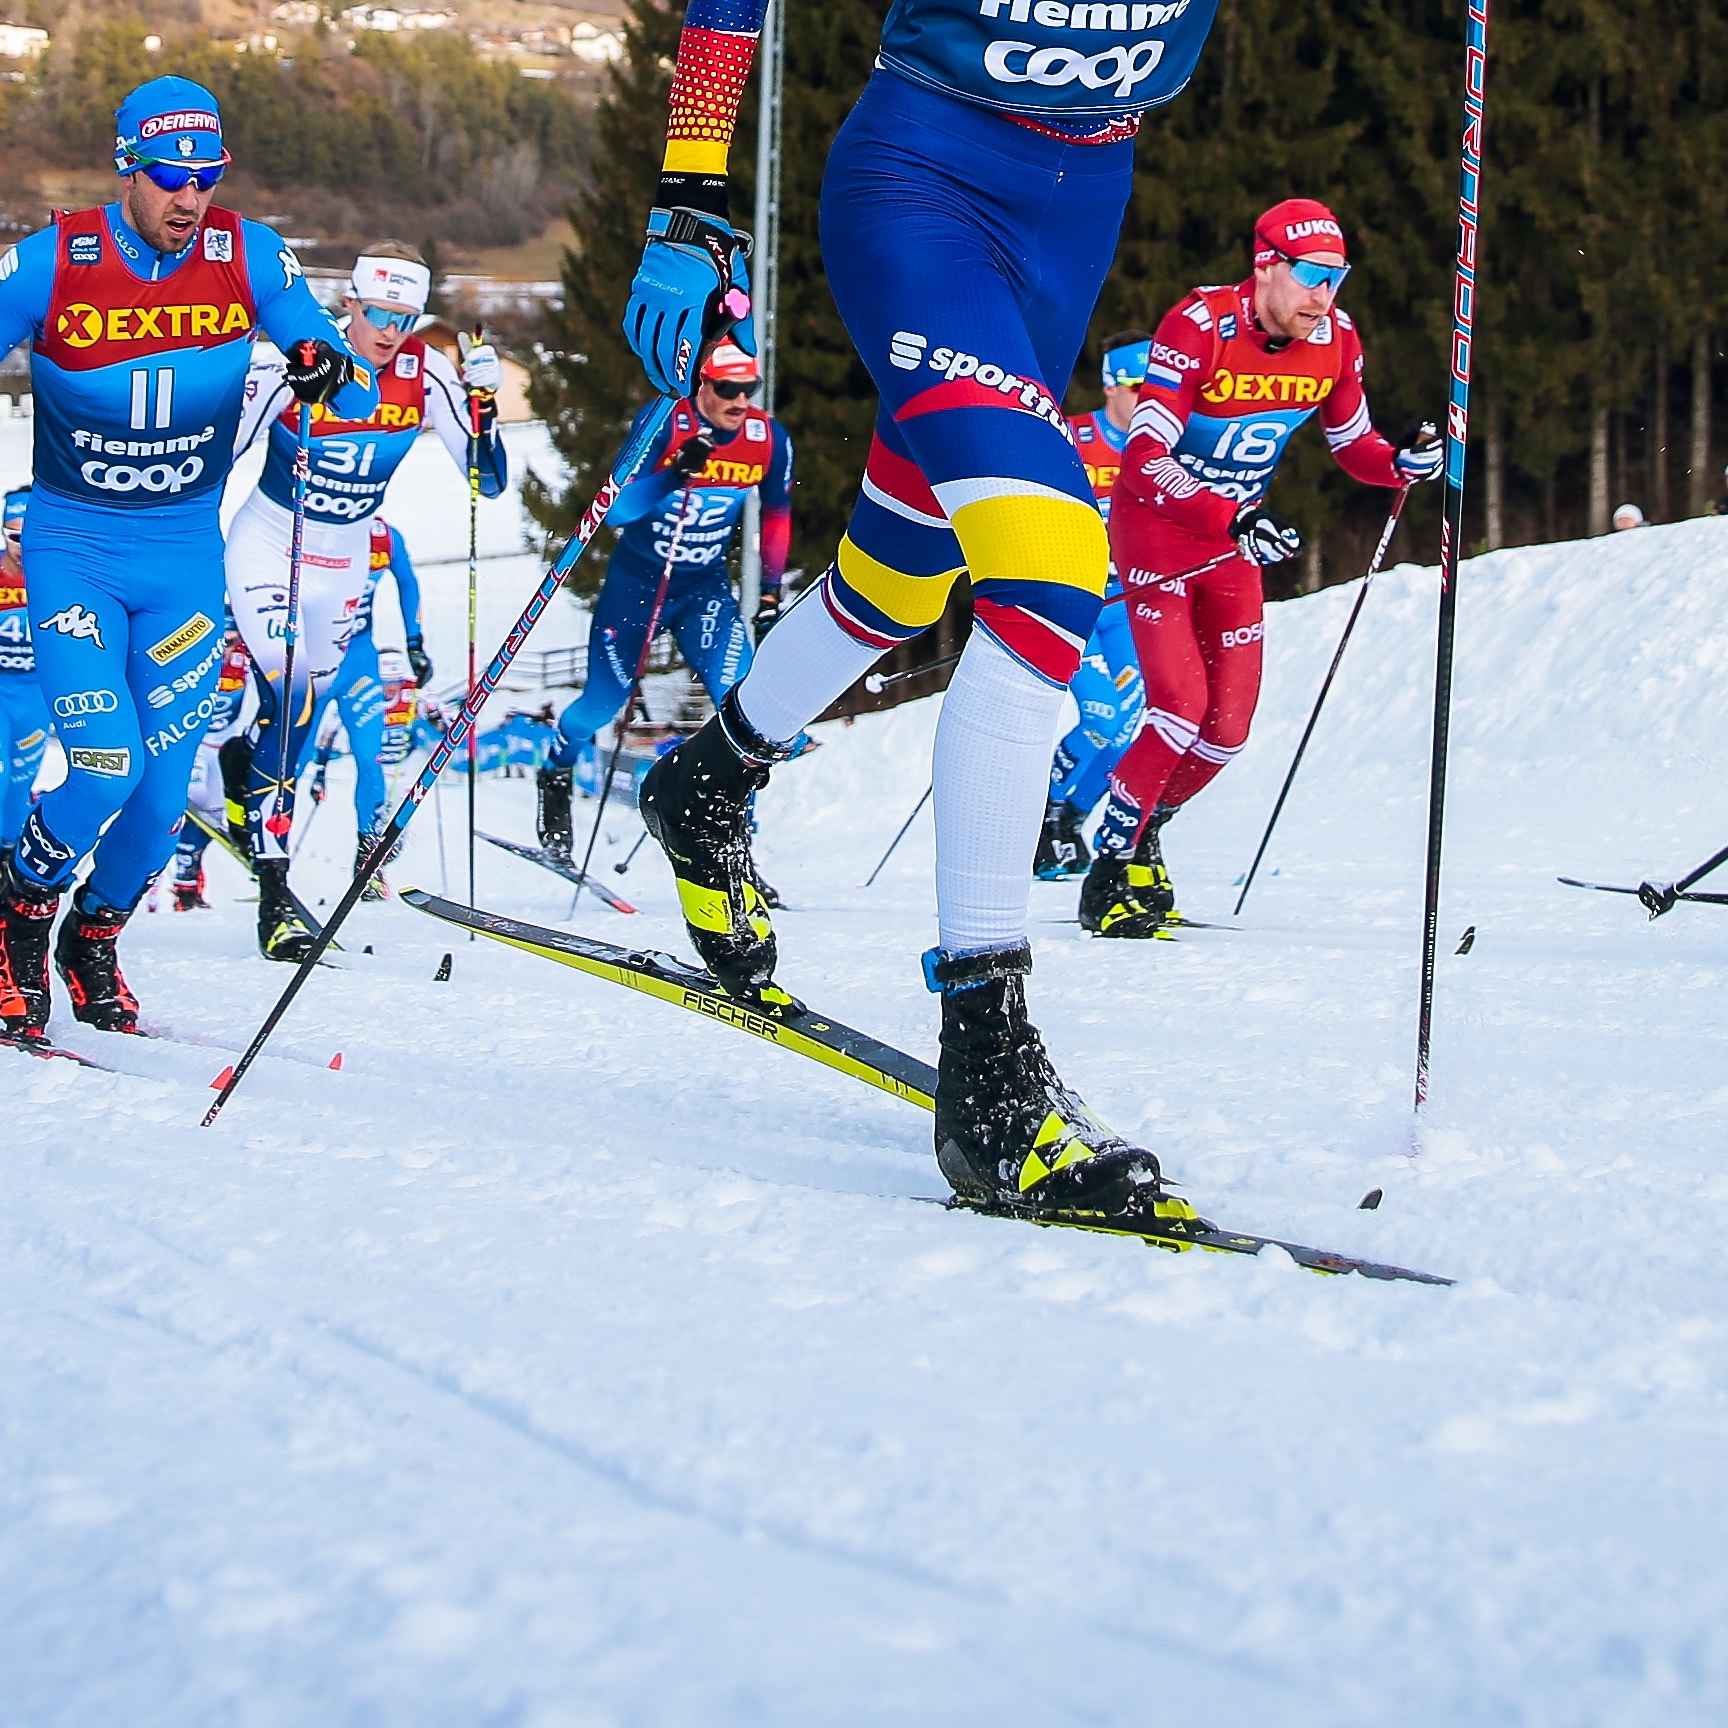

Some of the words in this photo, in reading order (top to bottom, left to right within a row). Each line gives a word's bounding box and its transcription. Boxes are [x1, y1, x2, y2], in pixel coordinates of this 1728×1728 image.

[984, 41, 1165, 97] coop
[107, 303, 250, 340] EXTRA
[131, 368, 174, 430] 11
[929, 347, 1075, 446] sportfu
[1234, 375, 1333, 402] EXTRA
[71, 426, 214, 456] fiemme
[317, 440, 376, 476] 31
[1213, 422, 1288, 463] 18
[81, 456, 204, 493] coop
[578, 472, 622, 544] KV+
[665, 490, 735, 526] 32
[155, 620, 206, 659] PARMACOTTO
[429, 566, 573, 775] TORNADO
[30, 814, 76, 859] coop
[683, 991, 779, 1041] FISCHER
